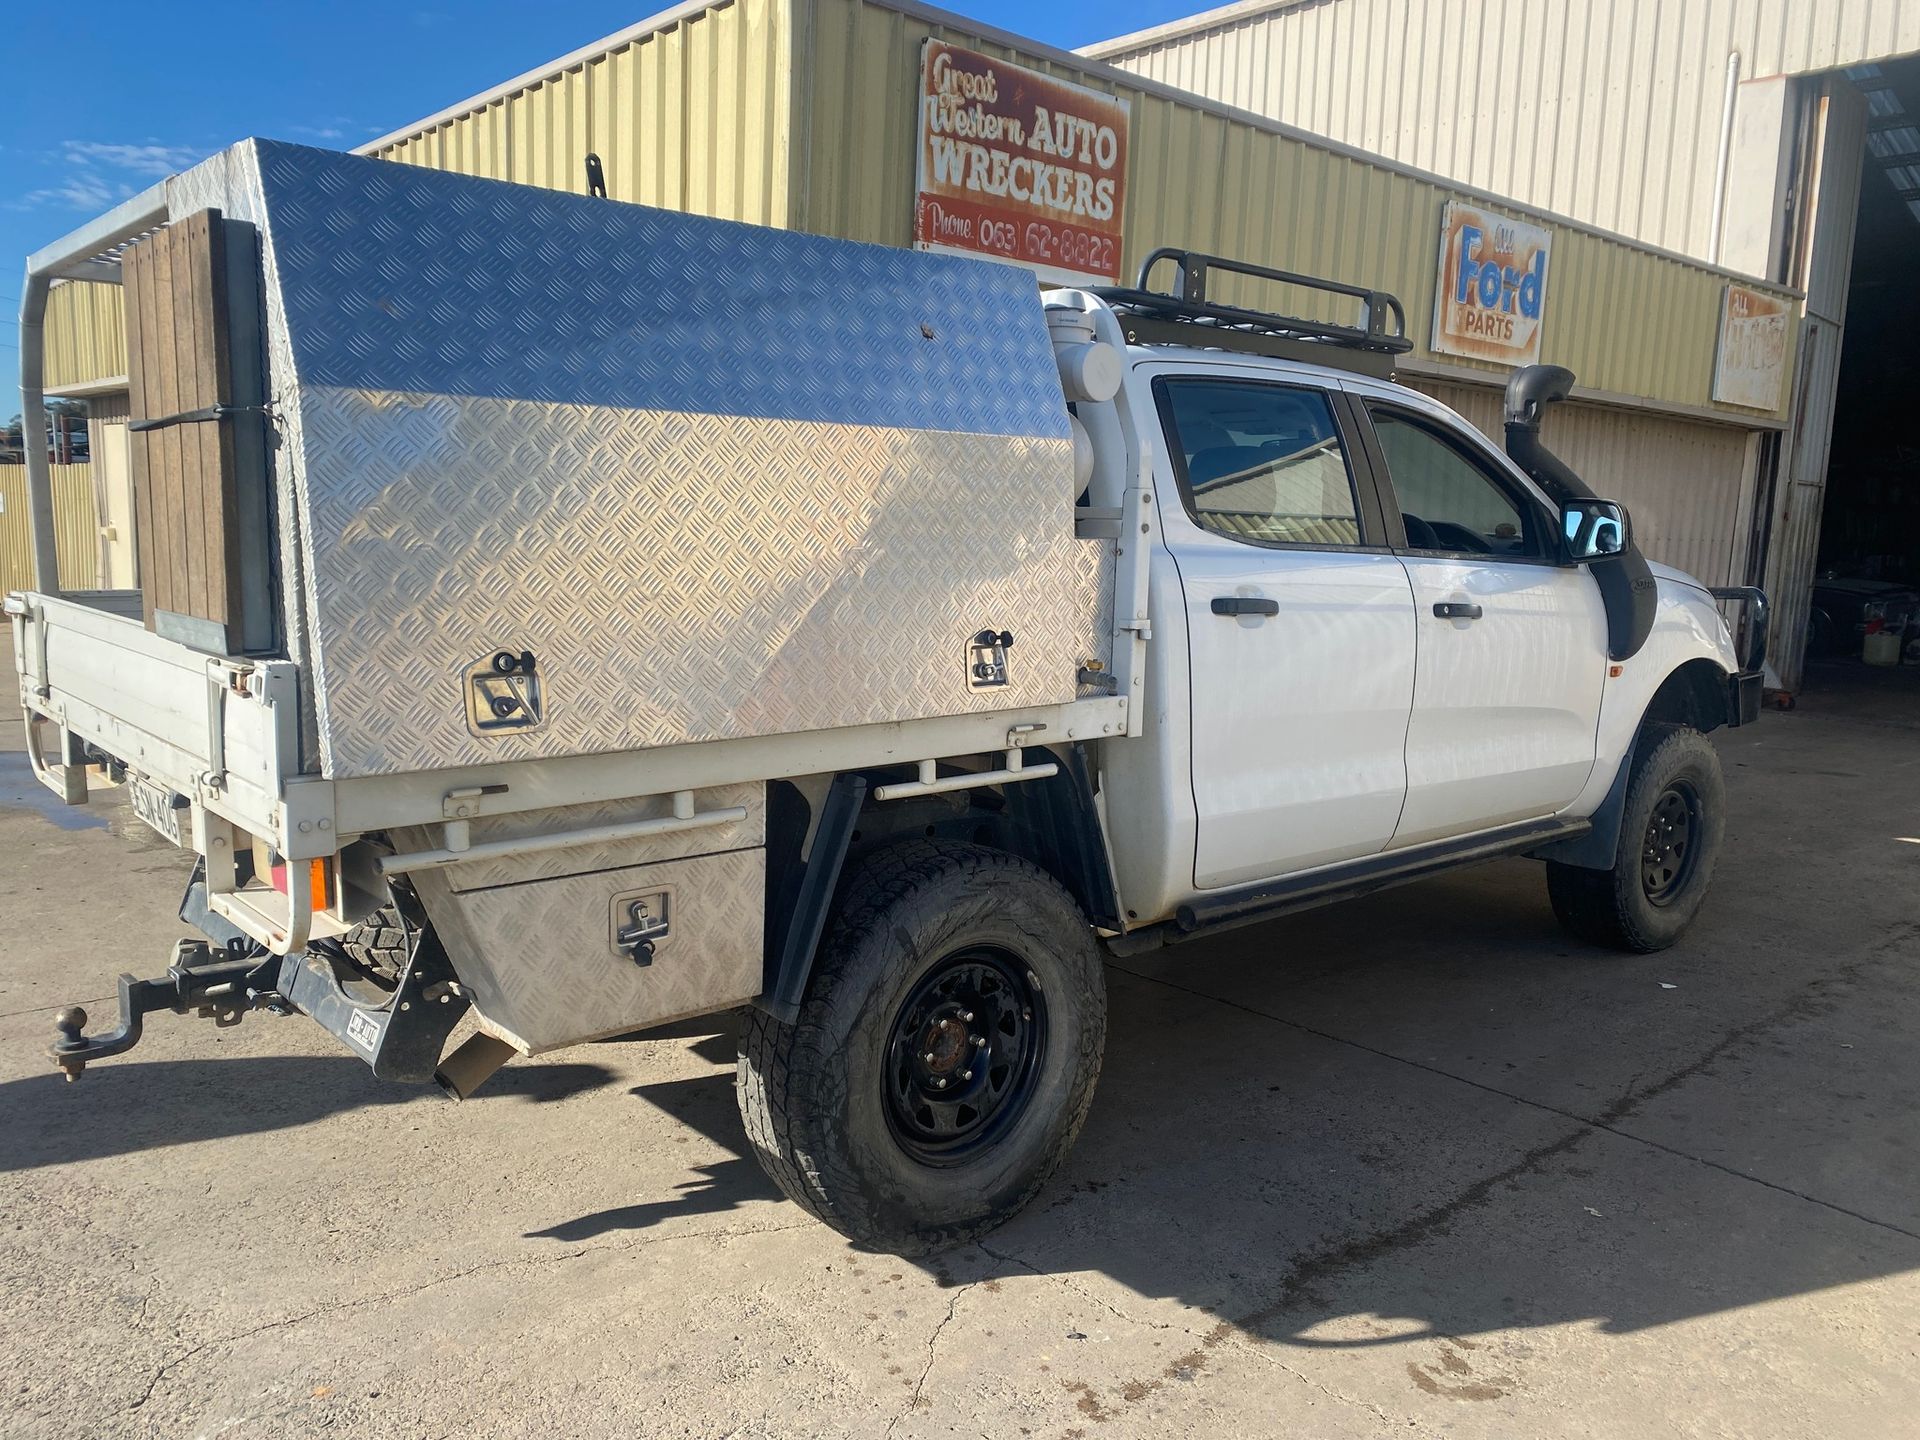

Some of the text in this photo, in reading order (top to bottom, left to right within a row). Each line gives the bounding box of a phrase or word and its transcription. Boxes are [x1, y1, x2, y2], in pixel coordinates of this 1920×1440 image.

[933, 53, 998, 104] Great
[928, 95, 1118, 170] Western AUTO
[929, 135, 1116, 221] WRECKERS
[977, 214, 1020, 256] (063)
[1455, 224, 1546, 321] Ford
[1466, 311, 1514, 340] PARTS
